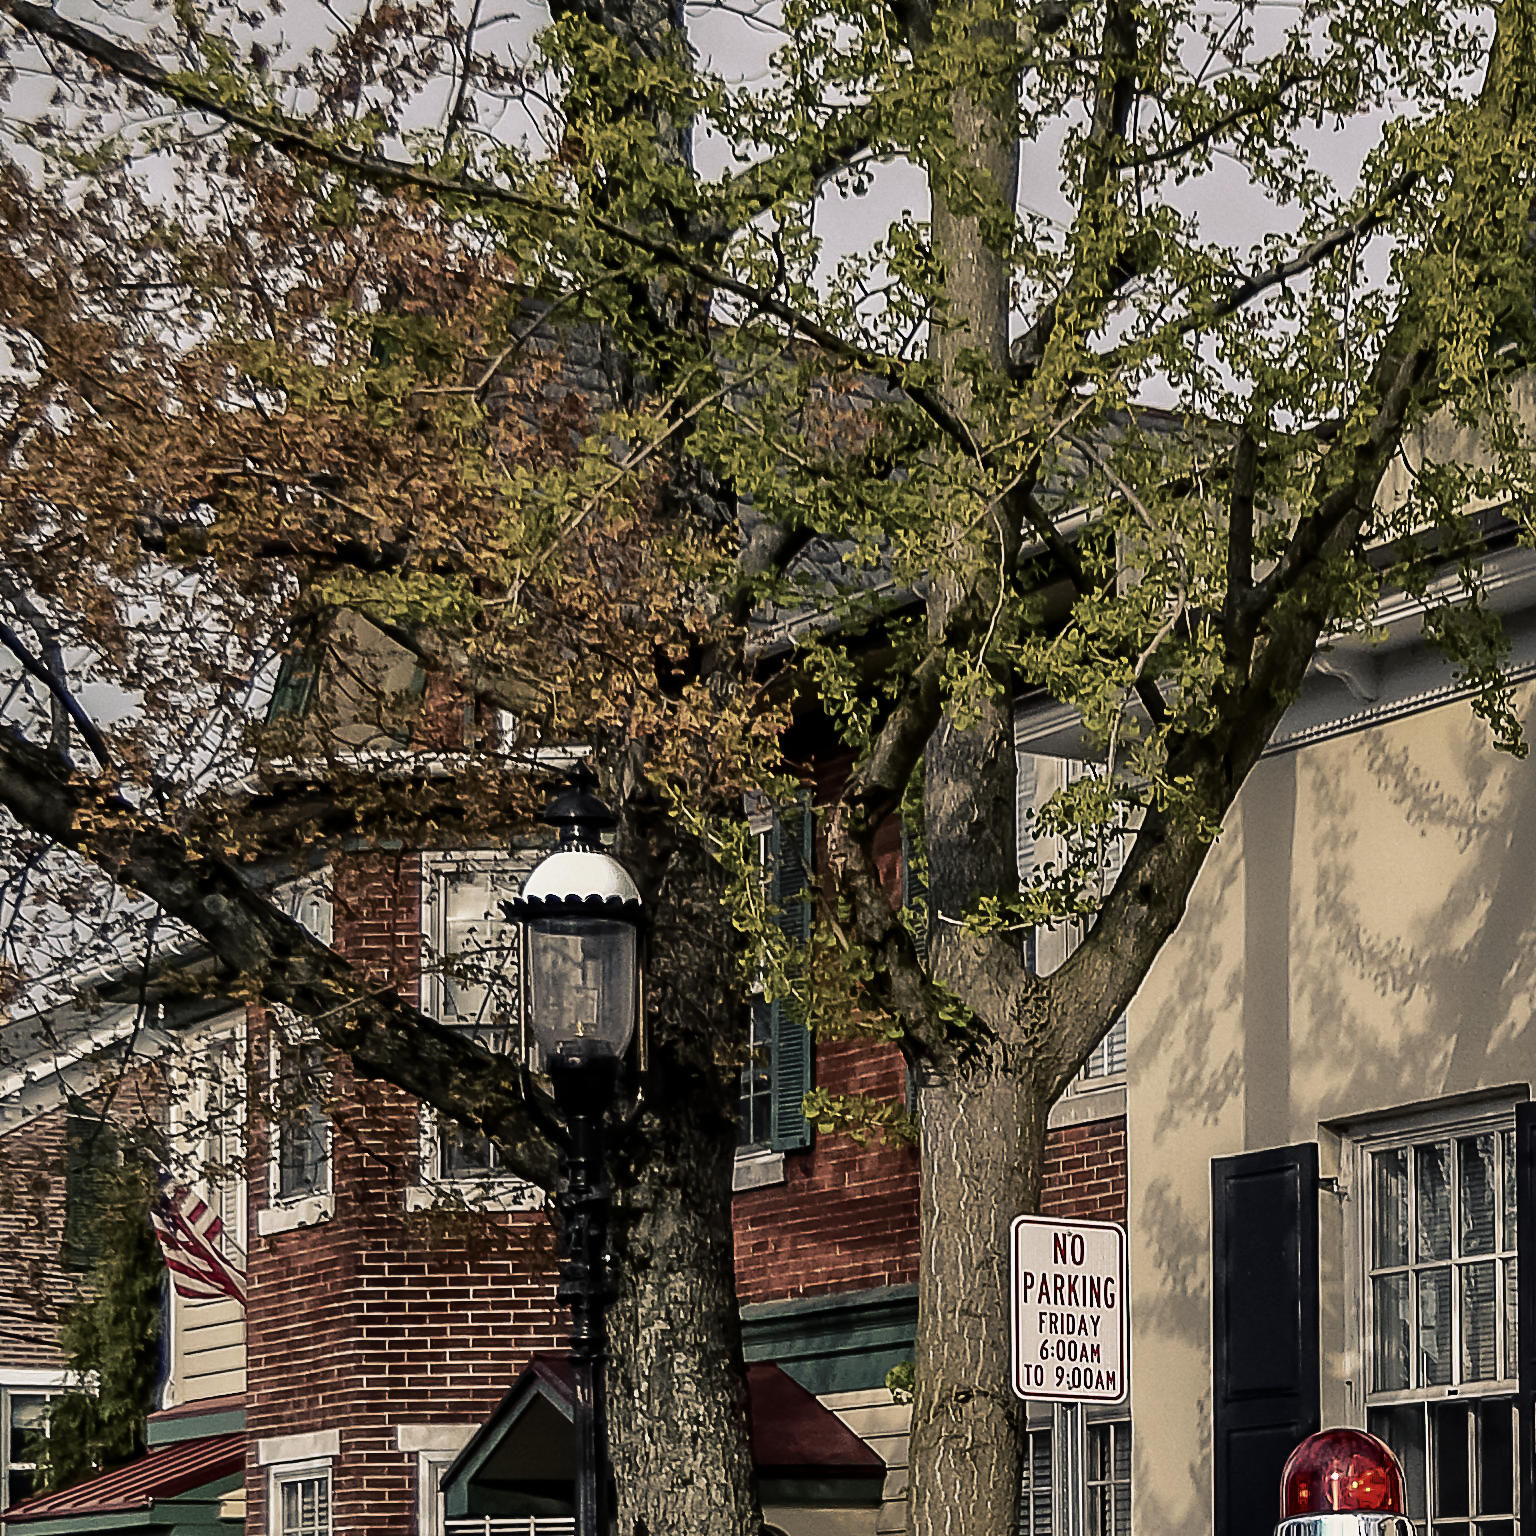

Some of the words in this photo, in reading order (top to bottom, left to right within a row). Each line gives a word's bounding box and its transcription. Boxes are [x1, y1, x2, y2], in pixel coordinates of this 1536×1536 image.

[1053, 1232, 1085, 1265] NO
[1023, 1271, 1115, 1309] PARKING
[1038, 1311, 1100, 1337] FRIDAY
[1039, 1339, 1101, 1364] 6:00AM
[1024, 1364, 1044, 1387] TO
[1055, 1365, 1116, 1391] 9:00AM
